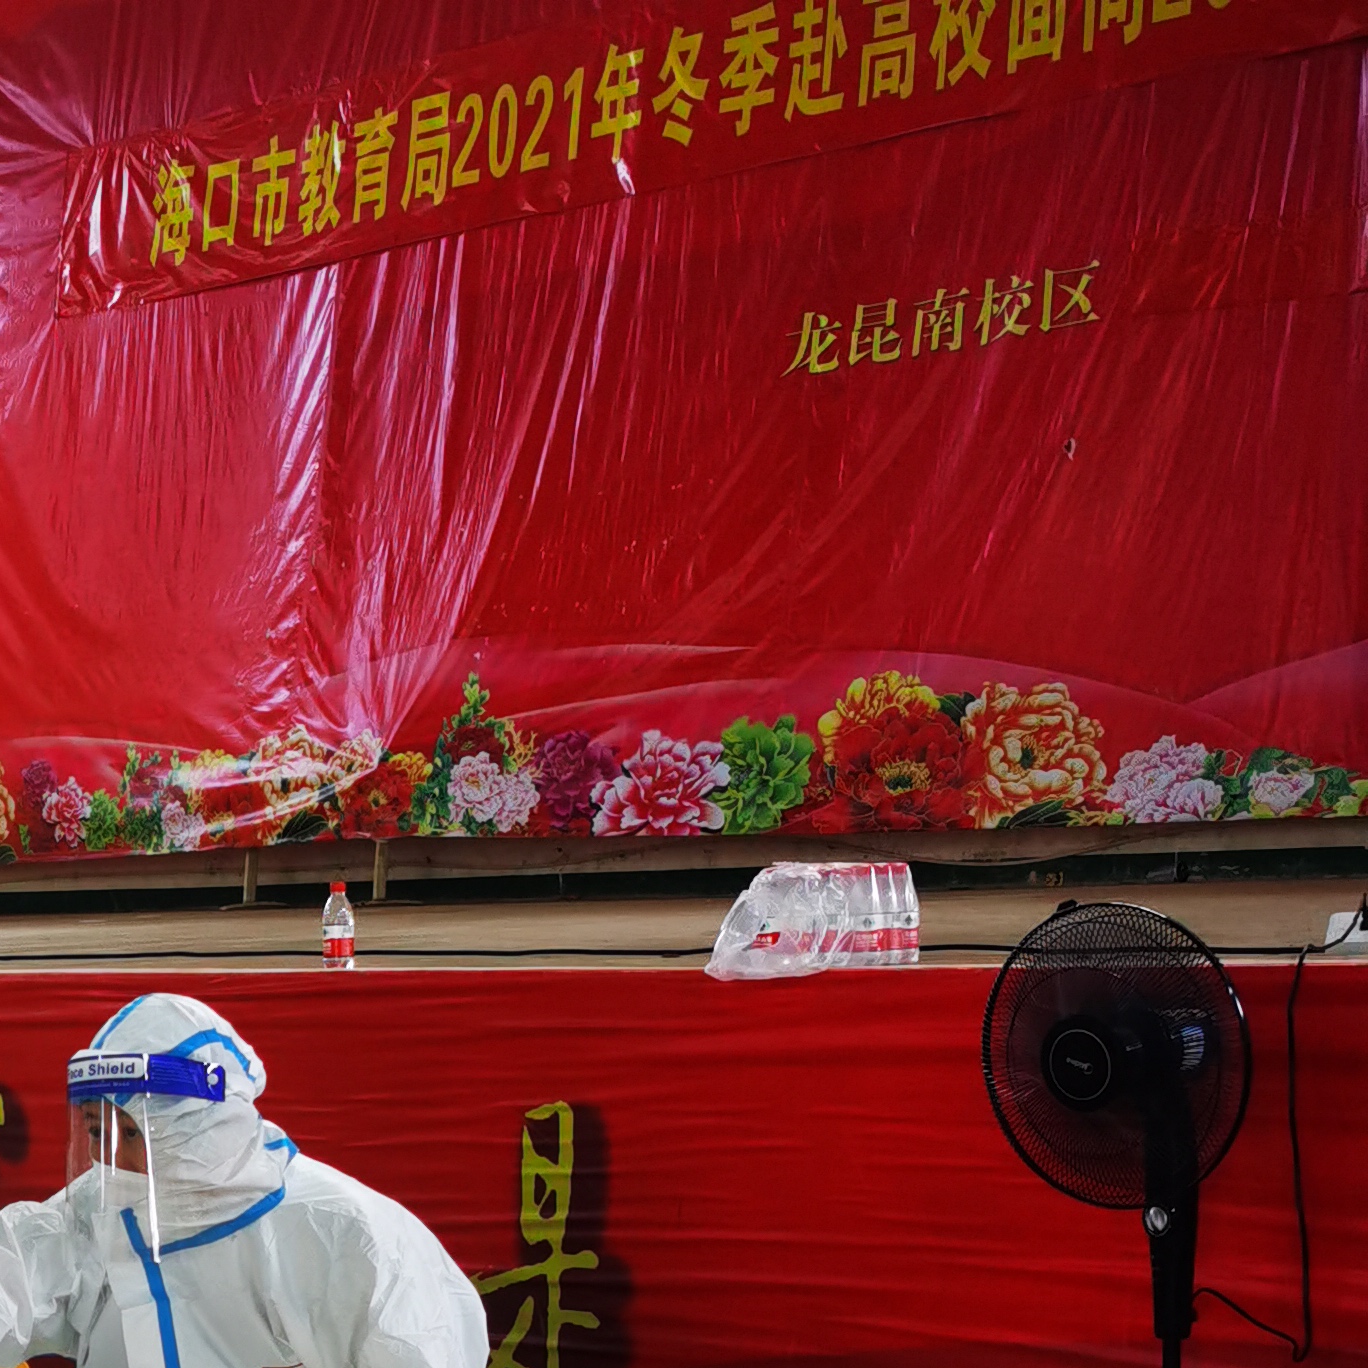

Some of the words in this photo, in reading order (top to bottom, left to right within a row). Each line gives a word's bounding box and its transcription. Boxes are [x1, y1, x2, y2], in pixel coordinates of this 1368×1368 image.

[149, 0, 1230, 268] 海口市教育局2021年冬季赴高校面
[780, 259, 1101, 378] 龙昆南校区
[88, 1061, 135, 1077] Shield
